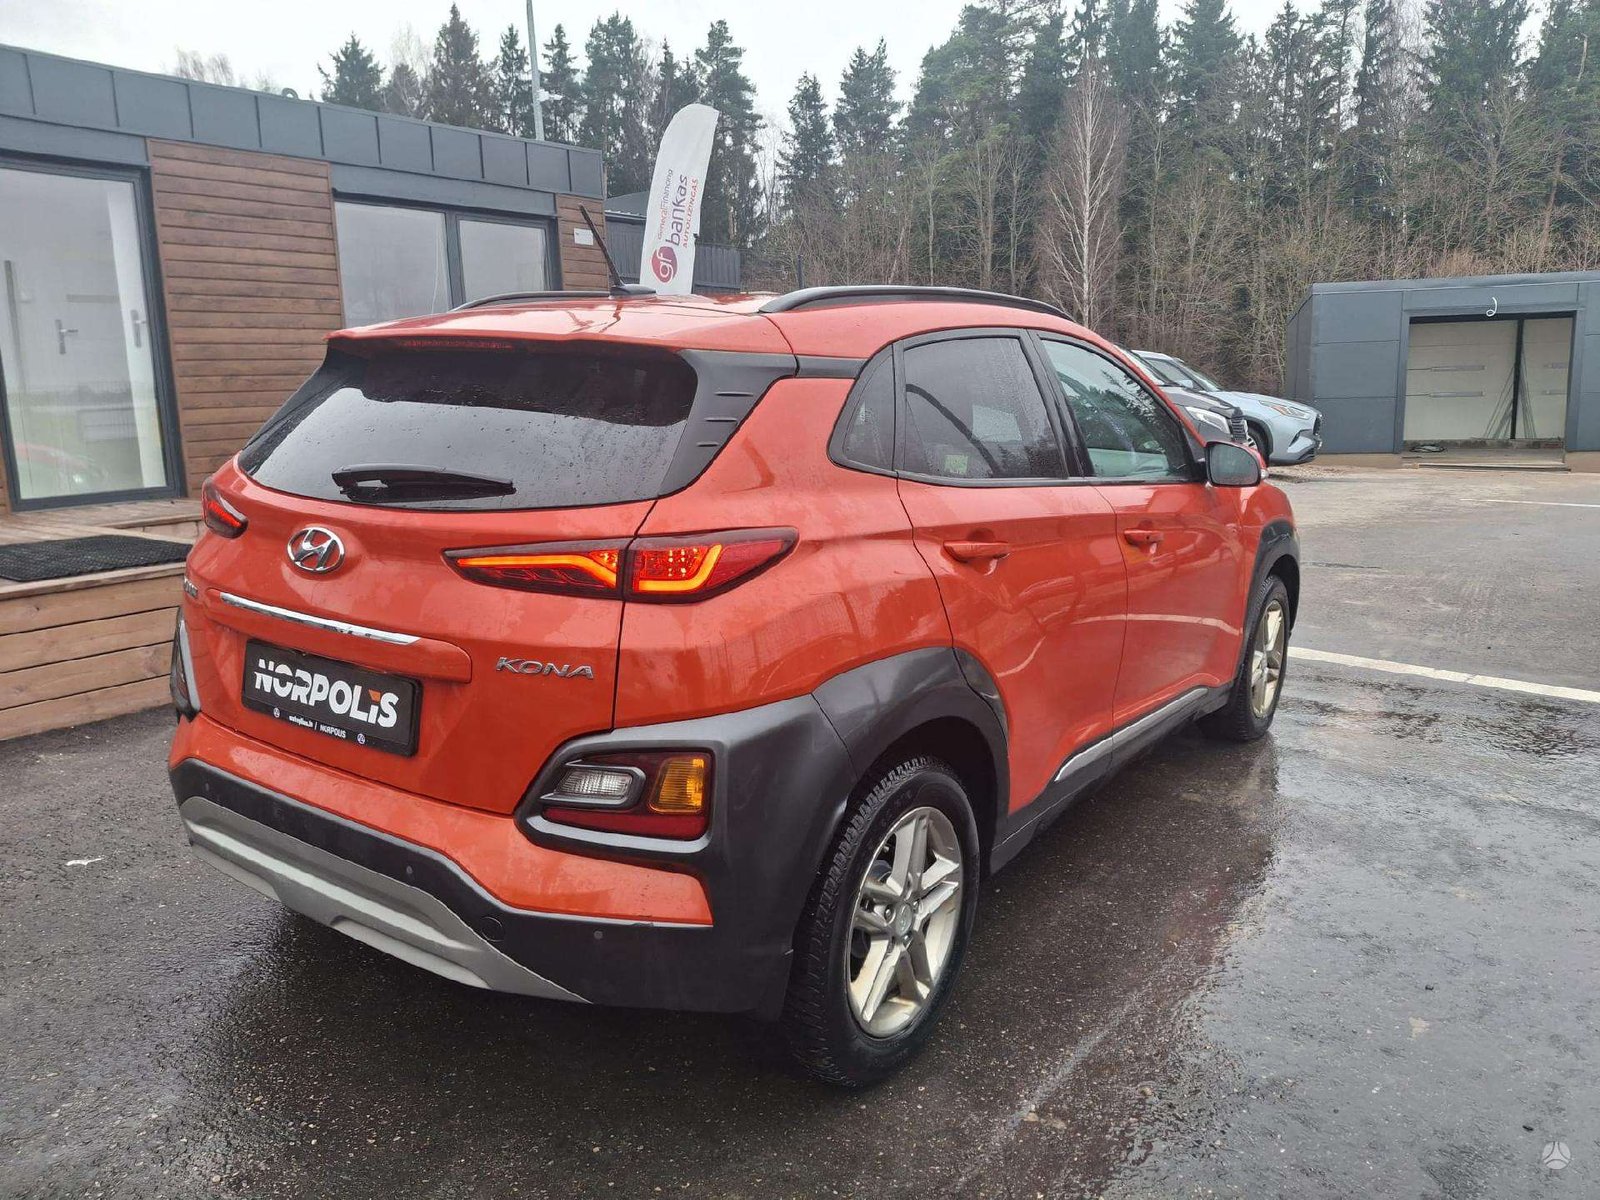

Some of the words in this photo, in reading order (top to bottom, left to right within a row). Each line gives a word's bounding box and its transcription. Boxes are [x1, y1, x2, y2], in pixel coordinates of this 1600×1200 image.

[665, 174, 688, 246] bankas
[682, 178, 698, 249] AUTOLIZINGAS
[496, 657, 593, 679] KONA
